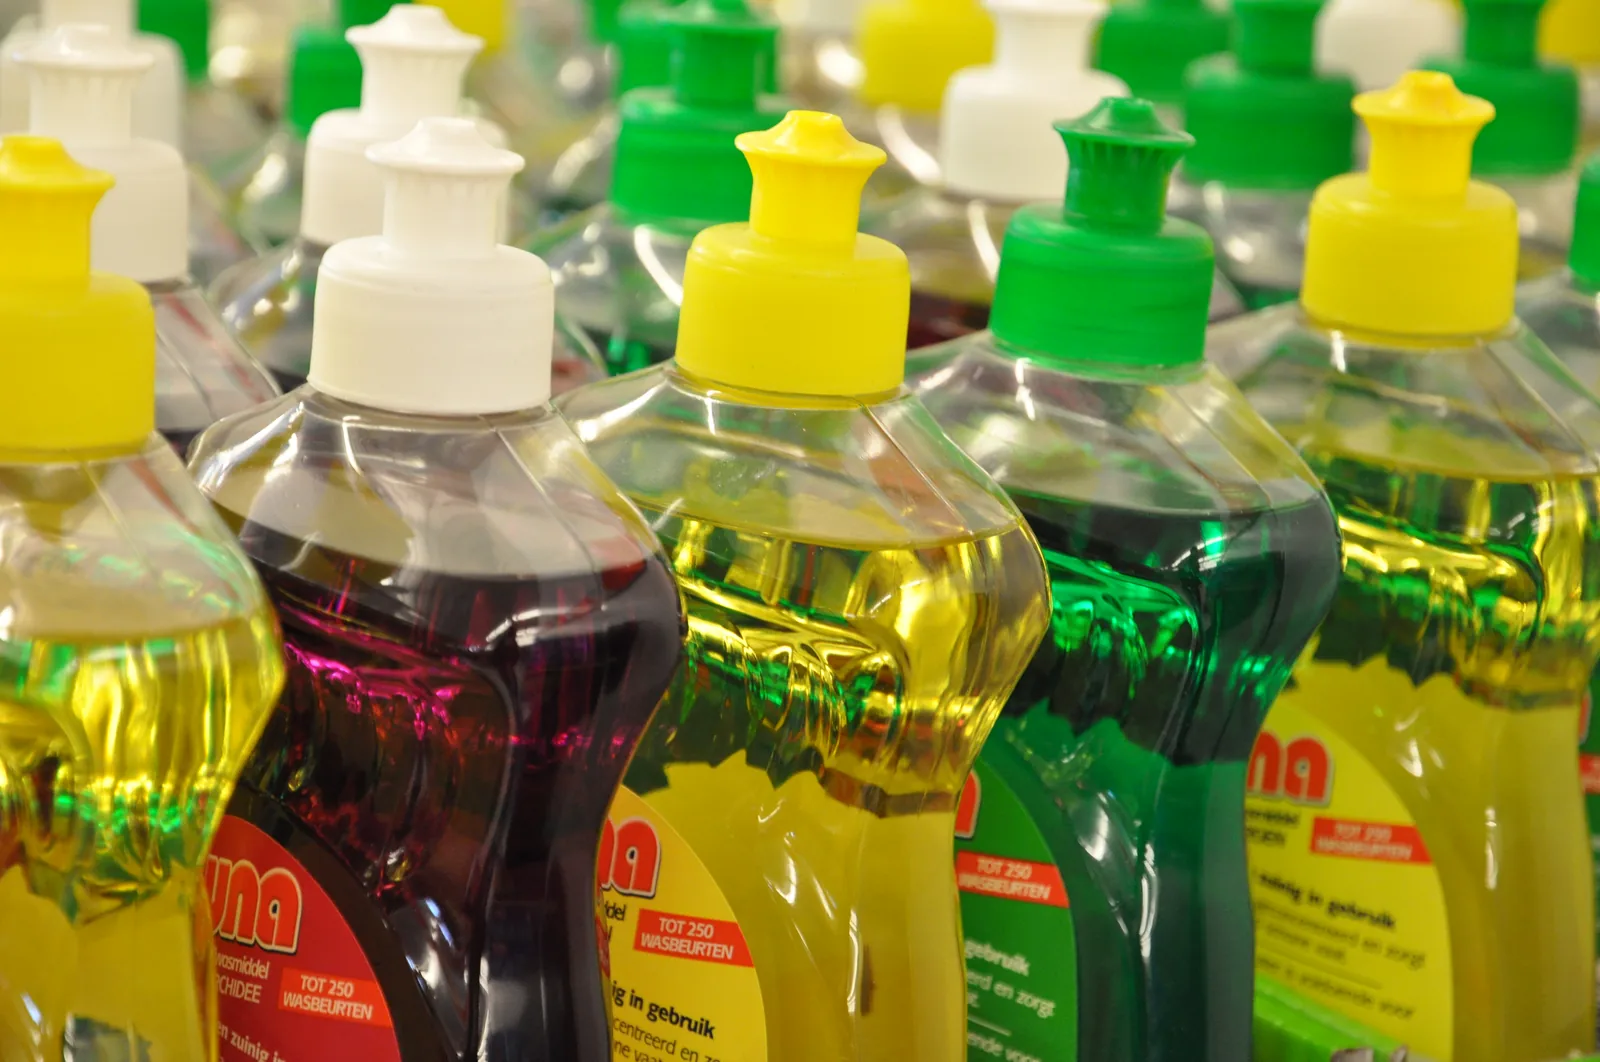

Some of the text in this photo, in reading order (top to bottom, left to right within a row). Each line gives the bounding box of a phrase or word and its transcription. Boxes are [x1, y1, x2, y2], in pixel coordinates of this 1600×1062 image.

[659, 917, 714, 939] TOT 250
[641, 931, 734, 960] WASBEURTEN
[301, 974, 354, 998] TOT 250
[283, 991, 373, 1020] WASBEURTEN
[629, 989, 644, 1011] in
[646, 1002, 715, 1040] gebruik
